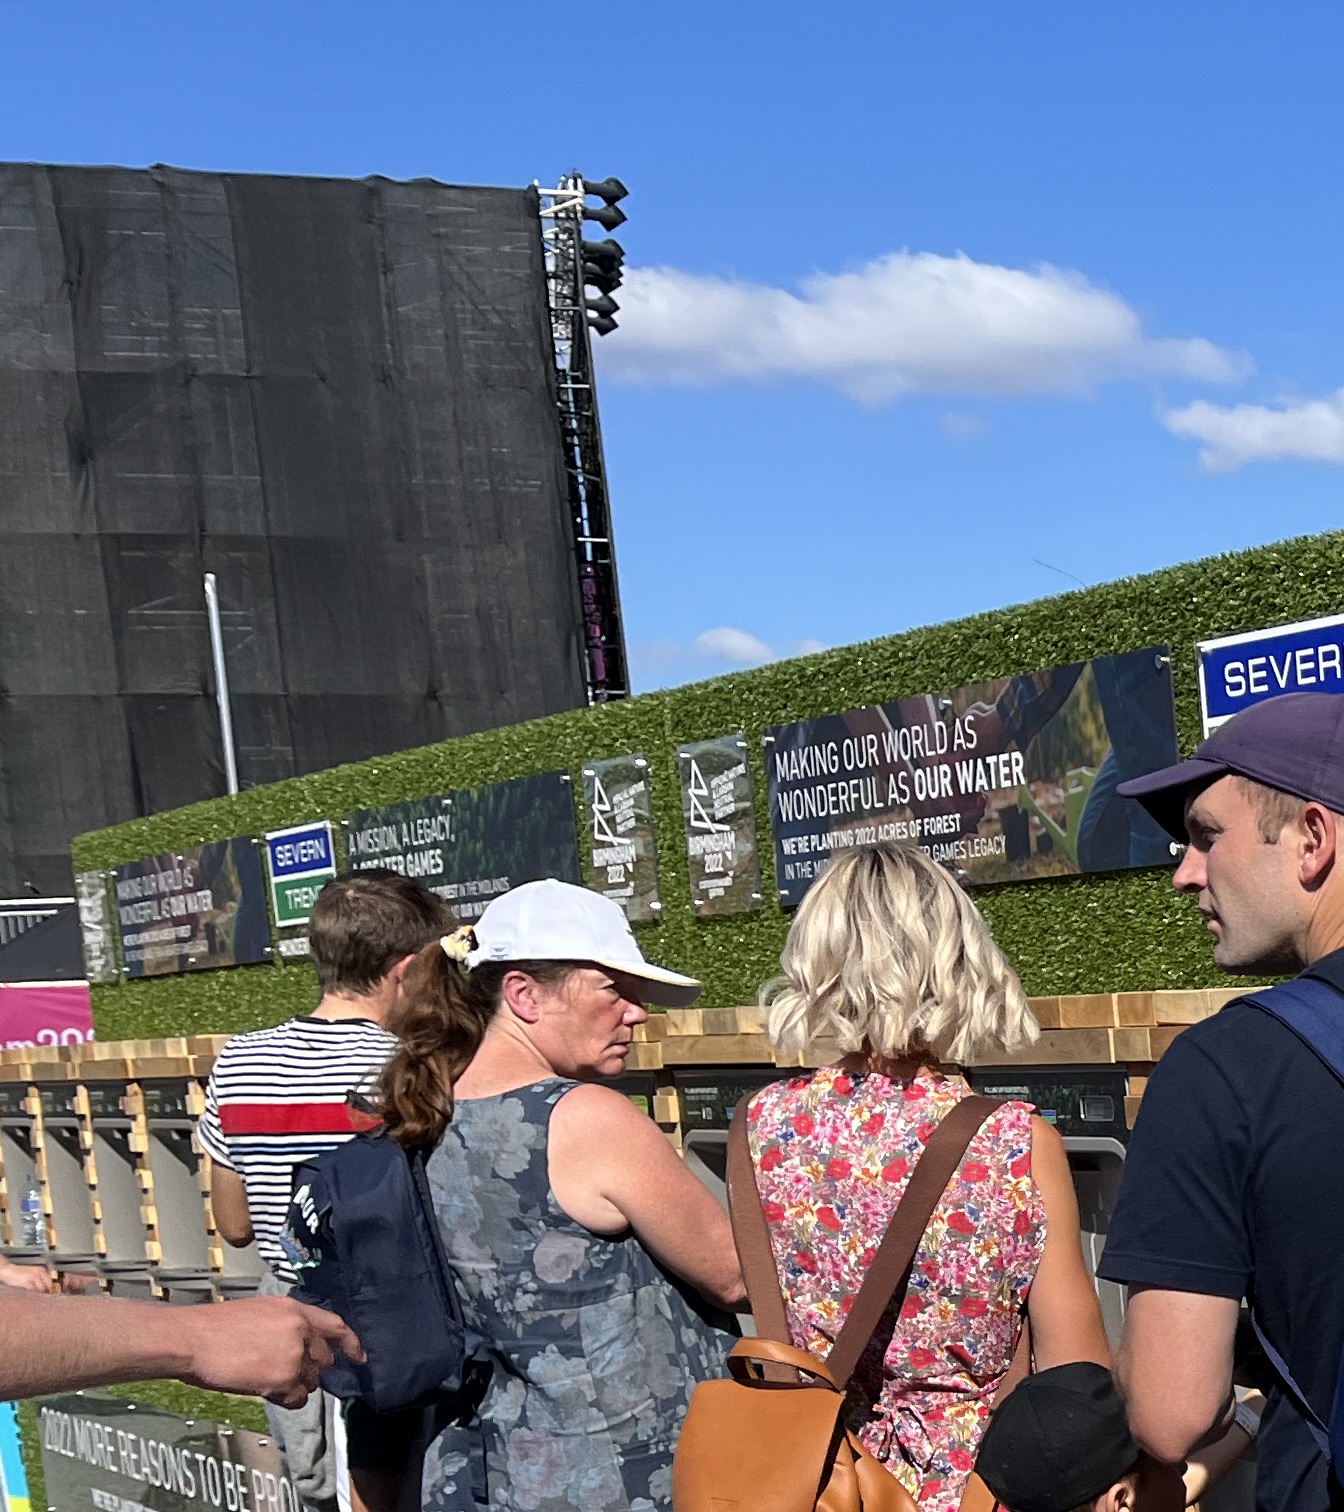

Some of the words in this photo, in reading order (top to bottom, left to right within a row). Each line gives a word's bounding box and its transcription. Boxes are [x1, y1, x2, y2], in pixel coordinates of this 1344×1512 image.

[775, 742, 839, 783] MAKING
[843, 734, 880, 771] OUR
[882, 720, 948, 764] WORLD
[954, 715, 977, 751] AS
[777, 776, 883, 822] WONDERFUL
[888, 772, 910, 805] AS
[914, 764, 953, 801] OUR
[956, 751, 1026, 795] WATER
[275, 838, 326, 867] SEVERN
[782, 835, 809, 855] WE'RE
[810, 829, 853, 851] PLANTING
[855, 826, 876, 845] 2022
[878, 821, 908, 842] ACRES
[909, 819, 922, 838] OF
[923, 813, 961, 836] FOREST
[406, 848, 444, 877] GAMES
[785, 863, 794, 880] IN
[796, 861, 813, 878] THE
[933, 840, 967, 862] GAMES
[969, 835, 1006, 858] LEGACY
[285, 884, 325, 910] TREN
[74, 1416, 118, 1472] MORE
[116, 1427, 196, 1498] REASONS
[195, 1452, 221, 1507] TO
